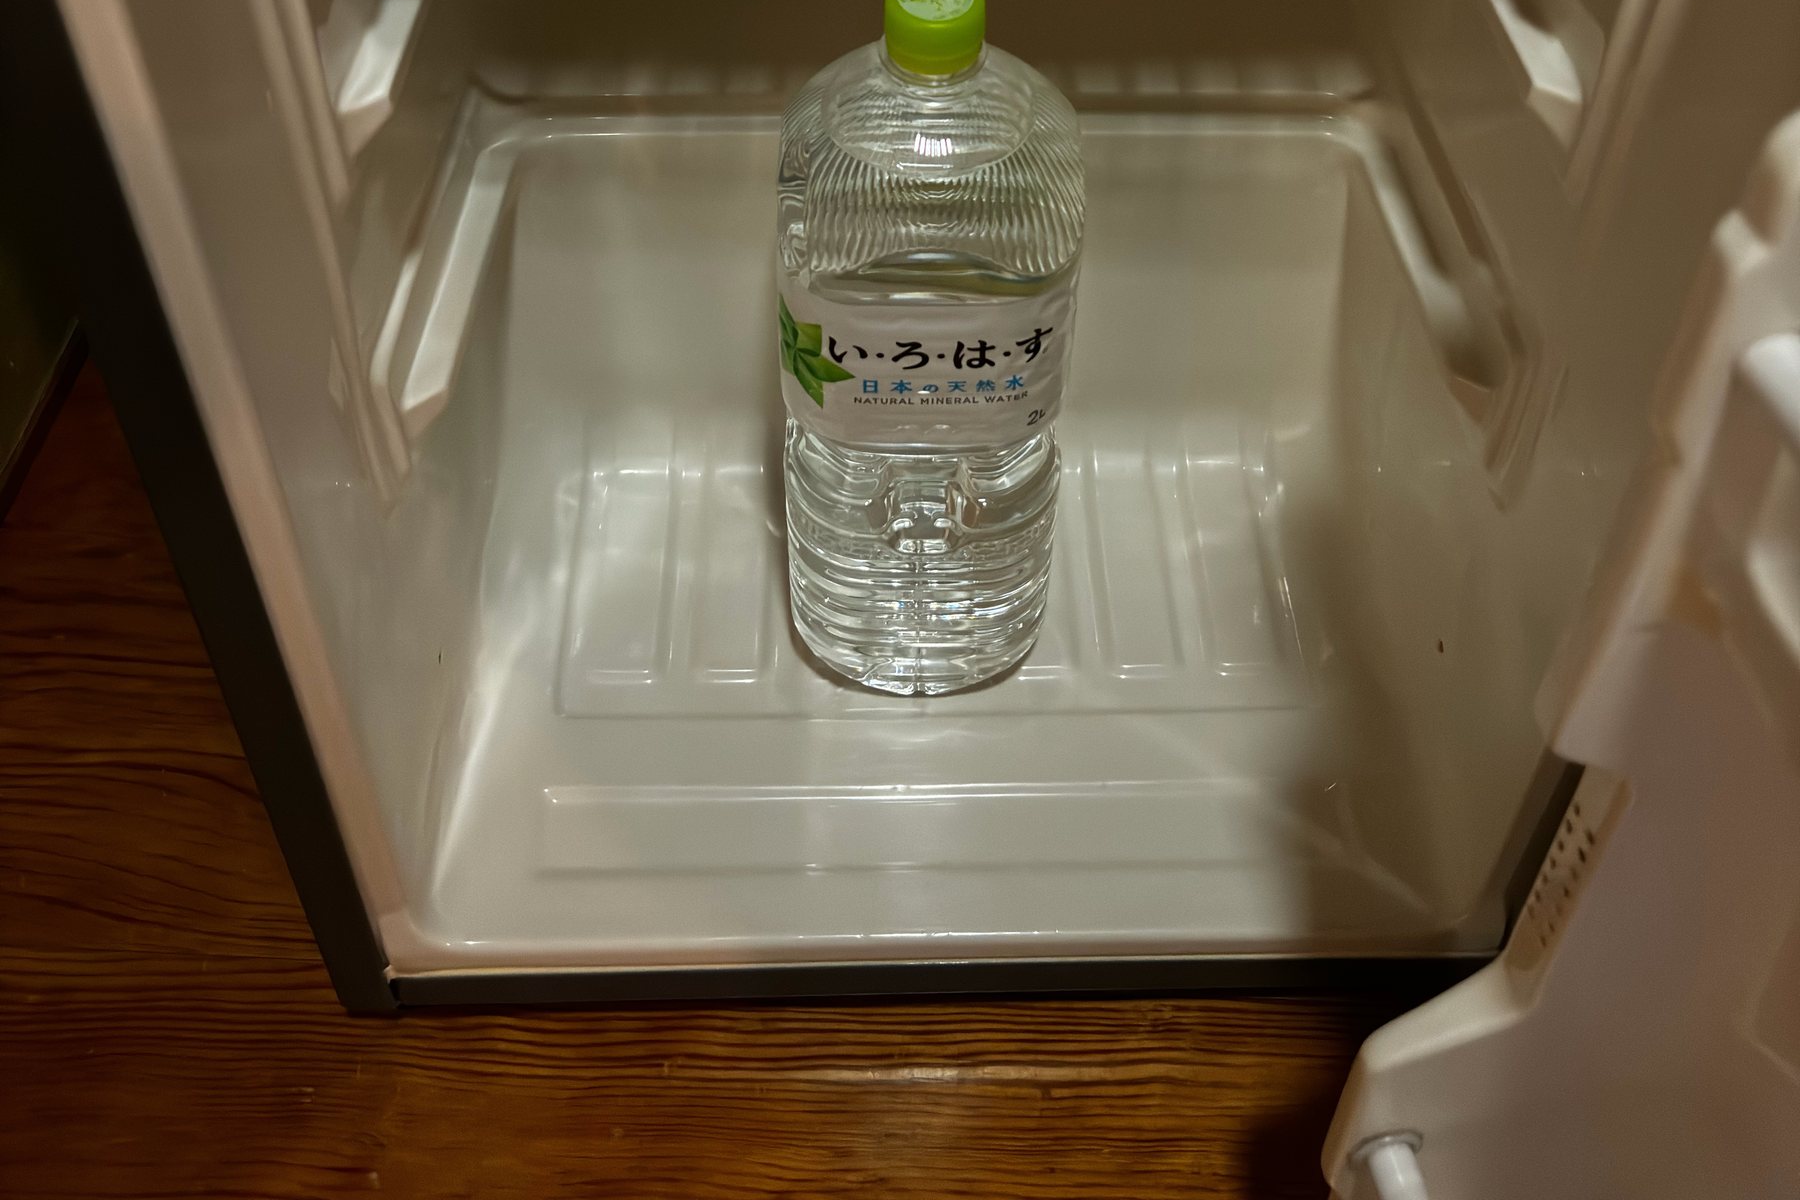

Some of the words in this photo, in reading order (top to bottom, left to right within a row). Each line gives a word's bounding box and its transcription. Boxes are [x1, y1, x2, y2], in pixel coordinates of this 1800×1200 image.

[862, 375, 1025, 393] 日本の天然水
[853, 396, 915, 405] NATURAL
[920, 396, 979, 405] MINERAL
[984, 391, 1028, 403] WATER
